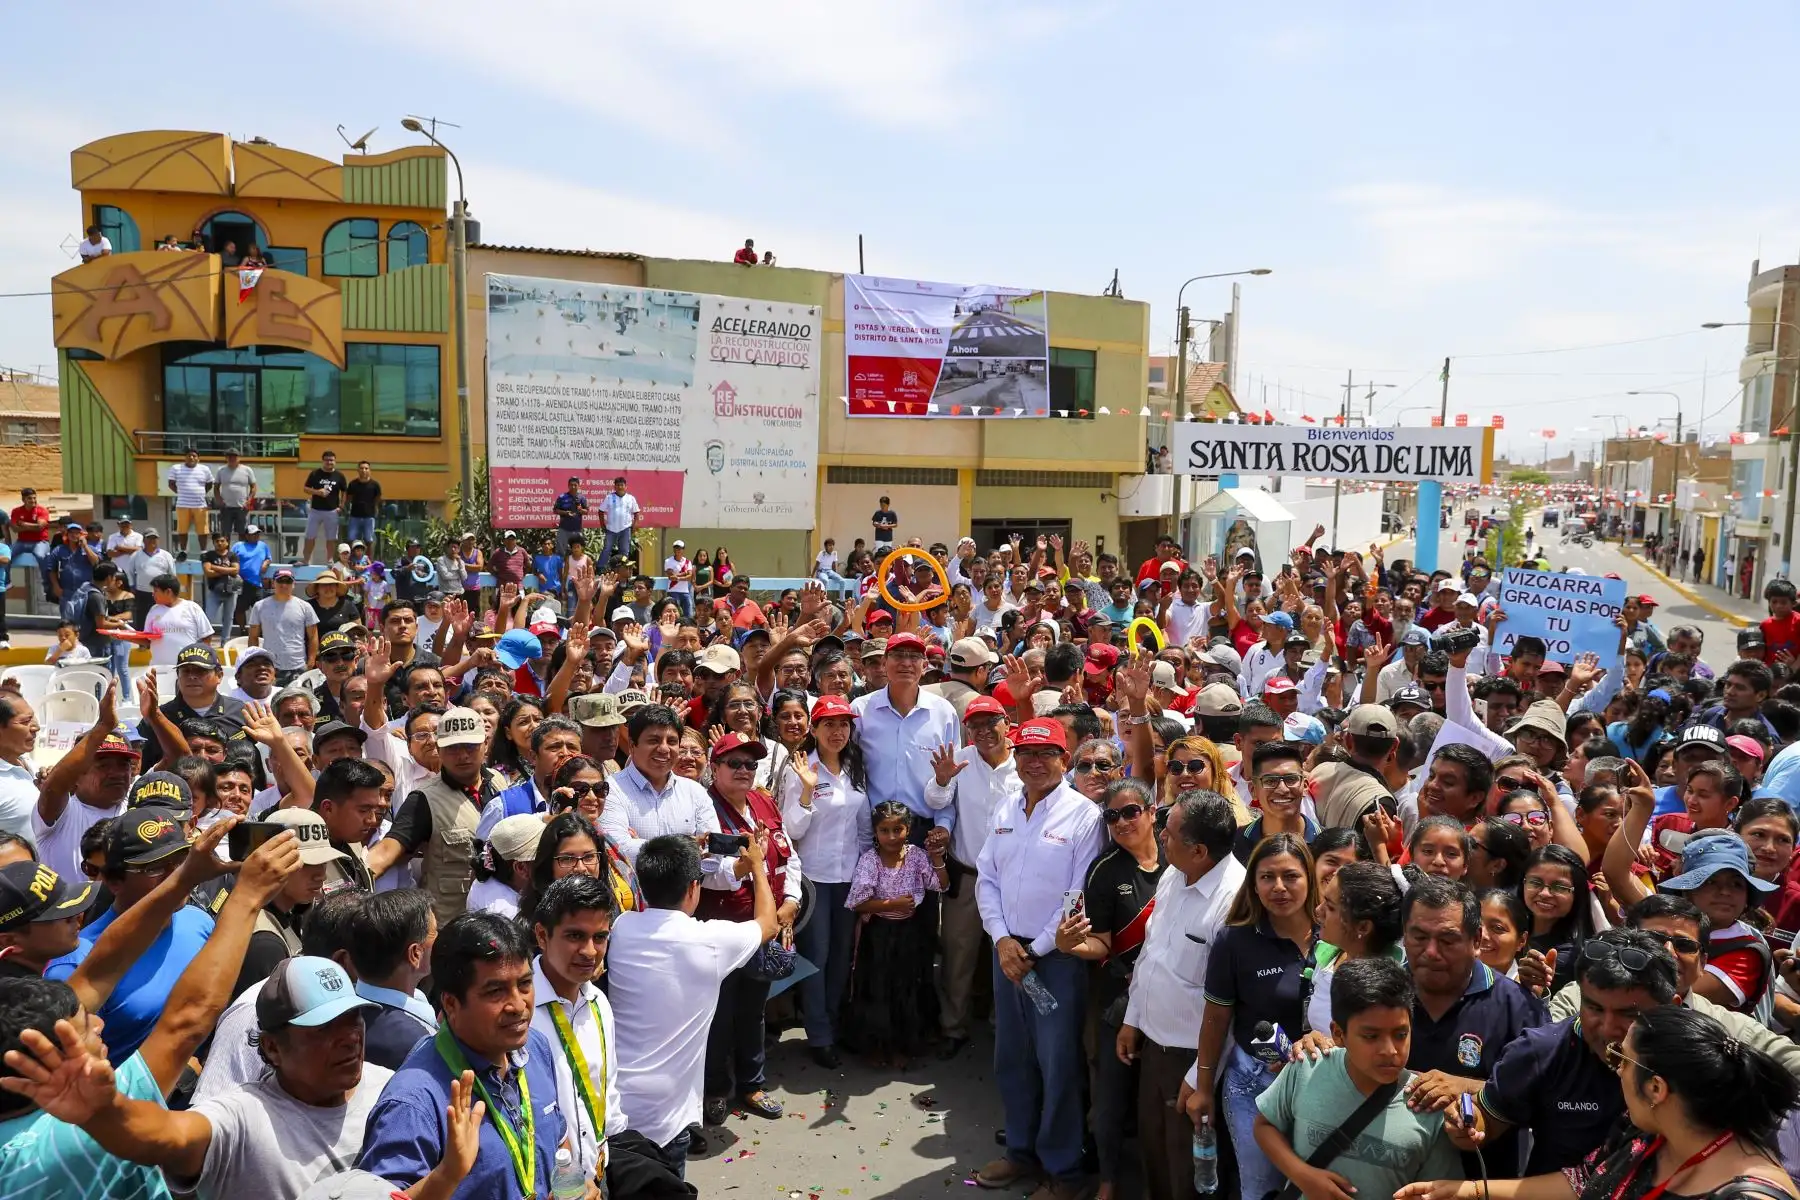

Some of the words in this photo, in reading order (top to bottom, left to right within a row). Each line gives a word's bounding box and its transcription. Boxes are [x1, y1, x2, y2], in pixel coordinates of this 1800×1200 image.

[256, 277, 313, 345] E
[711, 316, 811, 338] ACELERANDO
[854, 323, 879, 331] PISTAS
[711, 335, 722, 345] LA
[725, 336, 810, 353] RECONSTRUCCIÓN
[854, 334, 887, 342] DISTRITO
[899, 336, 923, 344] SANTA
[924, 337, 943, 345] ROSA
[710, 346, 741, 360] CON
[745, 349, 809, 366] CAMBIOS
[952, 345, 979, 354] Ahora
[562, 387, 569, 395] DE
[571, 387, 590, 397] TRAMO
[612, 390, 634, 399] AVENIDA
[717, 390, 733, 402] RE
[496, 396, 519, 406] TRAMO
[545, 399, 572, 409] AVENIDA
[573, 400, 587, 410] LUIS
[642, 404, 662, 413] TRAMO
[496, 409, 519, 419] AVENIDA
[520, 410, 547, 421] MARISCAL
[577, 413, 595, 423] TRAMO
[615, 415, 636, 425] AVENIDA
[496, 423, 516, 432] TRAMO
[535, 425, 557, 434] AVENIDA
[559, 426, 583, 435] ESTEBAN
[606, 428, 624, 437] TRAMO
[645, 429, 666, 439] AVENIDA
[674, 431, 680, 439] DE
[1307, 427, 1395, 441] Bienvenidos
[527, 437, 547, 447] TRAMO
[570, 439, 593, 449] AVENIDA
[645, 441, 663, 451] TRAMO
[496, 449, 520, 458] AVENIDA
[573, 451, 591, 461] TRAMO
[613, 452, 634, 461] AVENIDA
[744, 447, 794, 456] MUNICIPALIDAD
[1188, 440, 1287, 471] SANTA
[1291, 442, 1369, 473] ROSA
[1374, 443, 1410, 475] DE
[1413, 445, 1475, 477] LIMA
[730, 458, 758, 467] DISTRITAL
[759, 459, 768, 467] DE
[768, 459, 788, 468] SANTA
[789, 460, 807, 469] ROSA
[724, 504, 760, 513] Gobierno
[761, 505, 773, 513] del
[775, 505, 793, 513] Perú
[1508, 571, 1603, 597] VIZCARRA
[1504, 589, 1587, 613] GRACIAS
[1589, 602, 1621, 619] POR
[1547, 616, 1571, 632] TU
[321, 633, 349, 647] POLICIA
[1502, 633, 1570, 654] AYO
[180, 647, 210, 661] POLICIA
[618, 691, 647, 705] USEG
[444, 717, 475, 732] USEG
[1682, 725, 1719, 742] KING
[136, 781, 182, 803] POLICIA
[298, 823, 330, 842] USE
[1256, 966, 1284, 978] KIARA
[1557, 1101, 1599, 1111] ORLANDO
